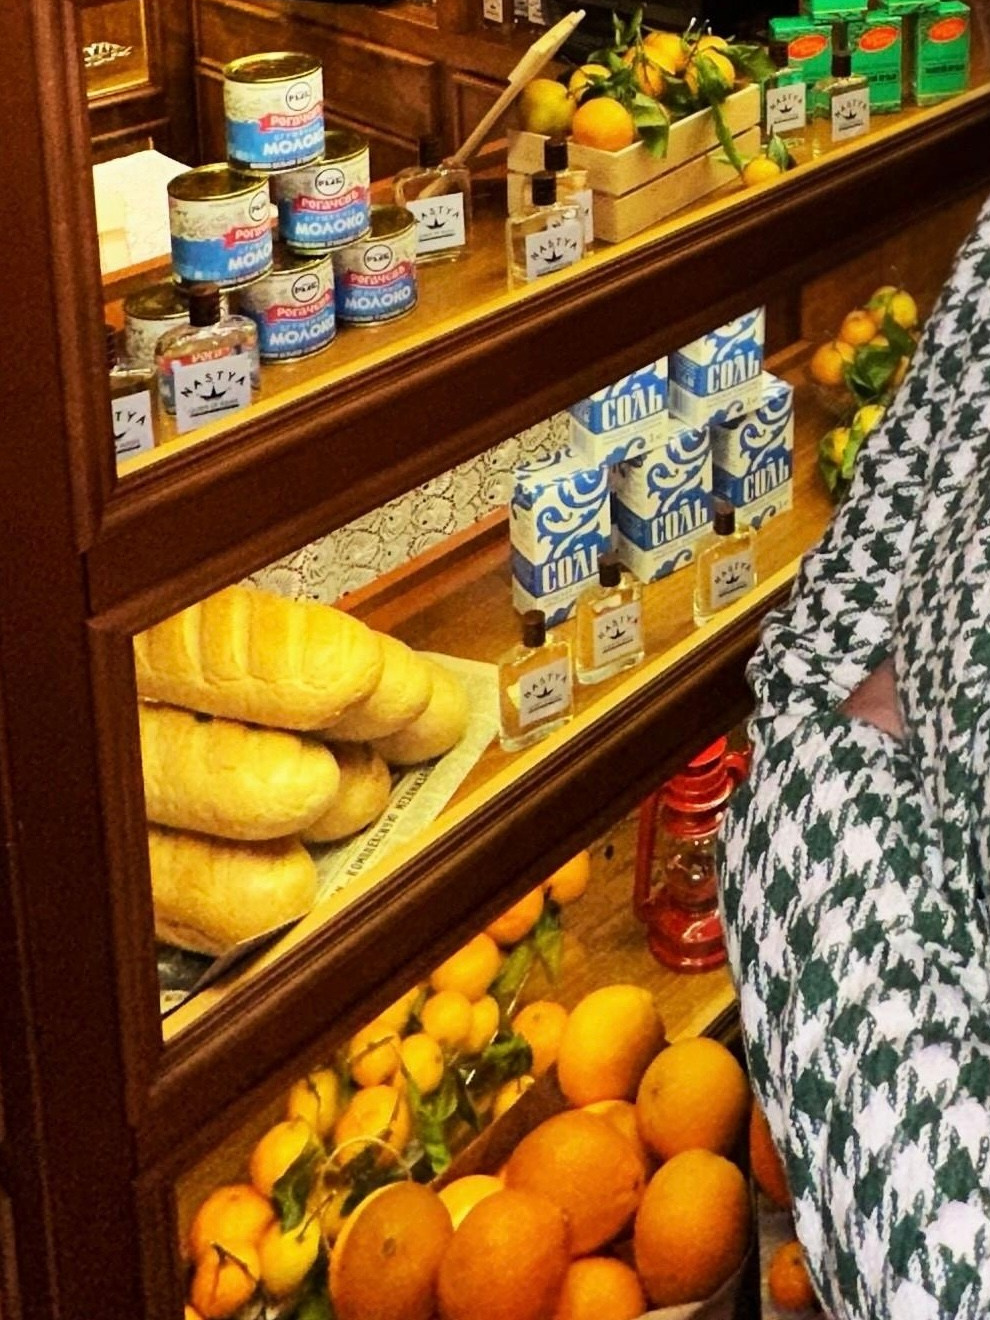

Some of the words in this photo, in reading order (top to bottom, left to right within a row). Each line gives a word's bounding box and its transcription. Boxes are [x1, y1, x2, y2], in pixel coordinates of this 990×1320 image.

[295, 211, 365, 236] МОЛОКО
[228, 243, 272, 272] МОЛО
[180, 369, 247, 398] NASTYA
[706, 349, 760, 394] СОЛЬ
[601, 382, 663, 430] СОЛЬ
[651, 498, 708, 547] СОЛЬ
